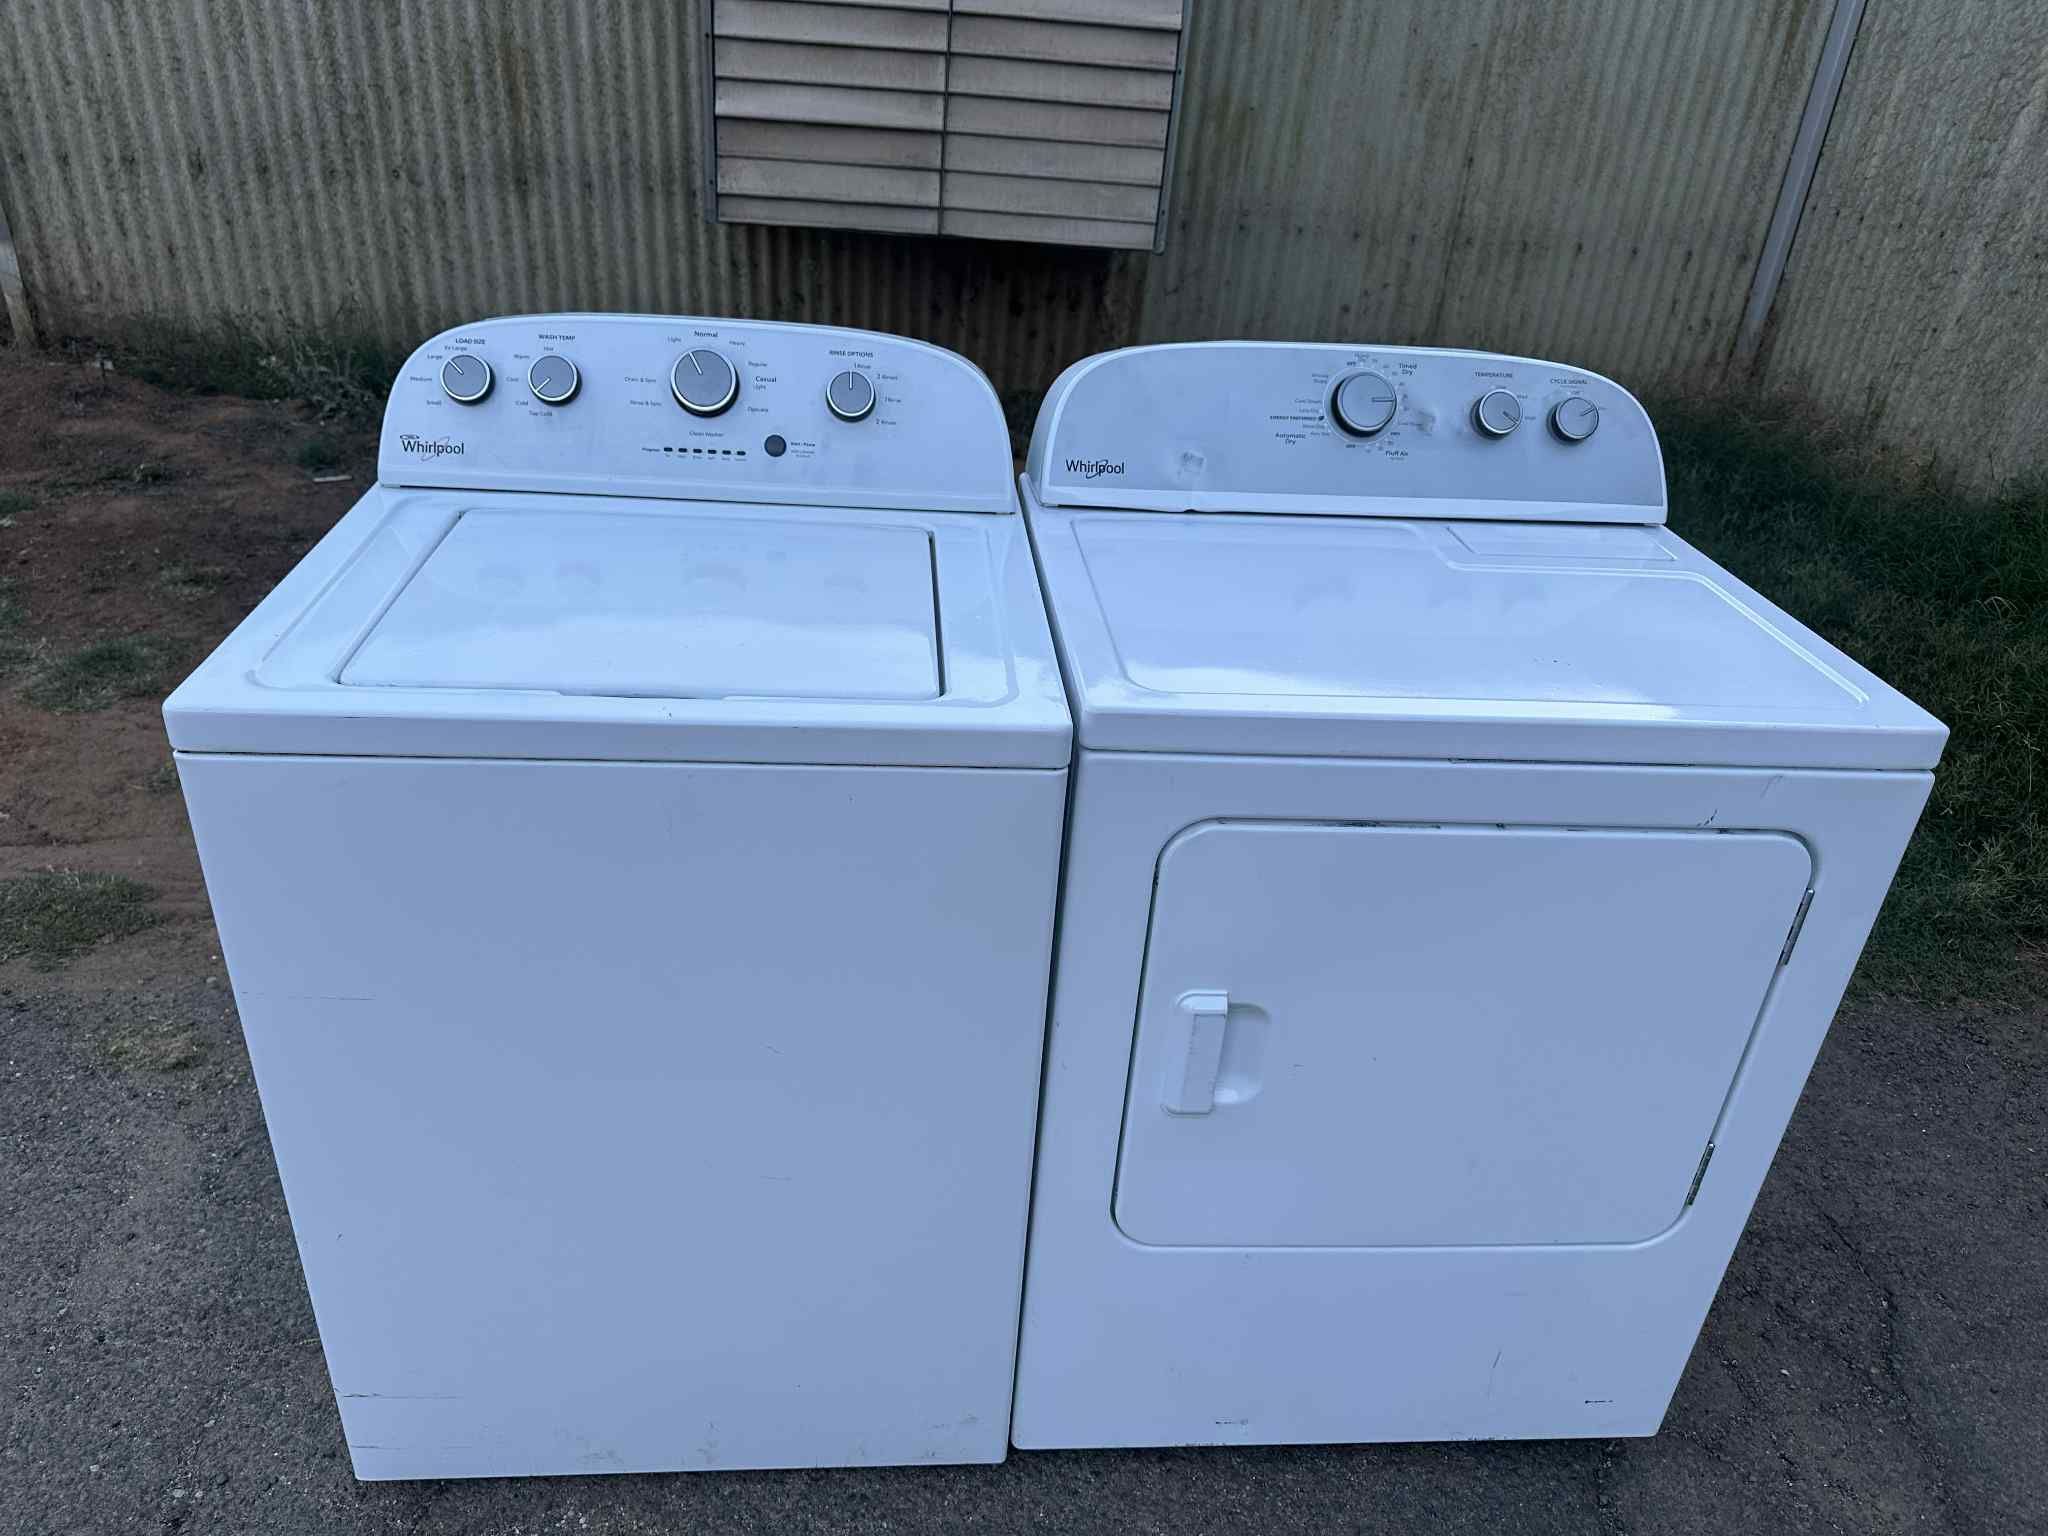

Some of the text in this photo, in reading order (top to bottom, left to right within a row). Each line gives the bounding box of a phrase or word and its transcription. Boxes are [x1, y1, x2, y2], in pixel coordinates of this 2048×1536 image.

[693, 330, 719, 338] Normal
[455, 337, 473, 345] LOAD
[755, 375, 777, 383] Casual
[401, 439, 465, 457] Whirlpool
[1065, 458, 1126, 478] Whirlpool
